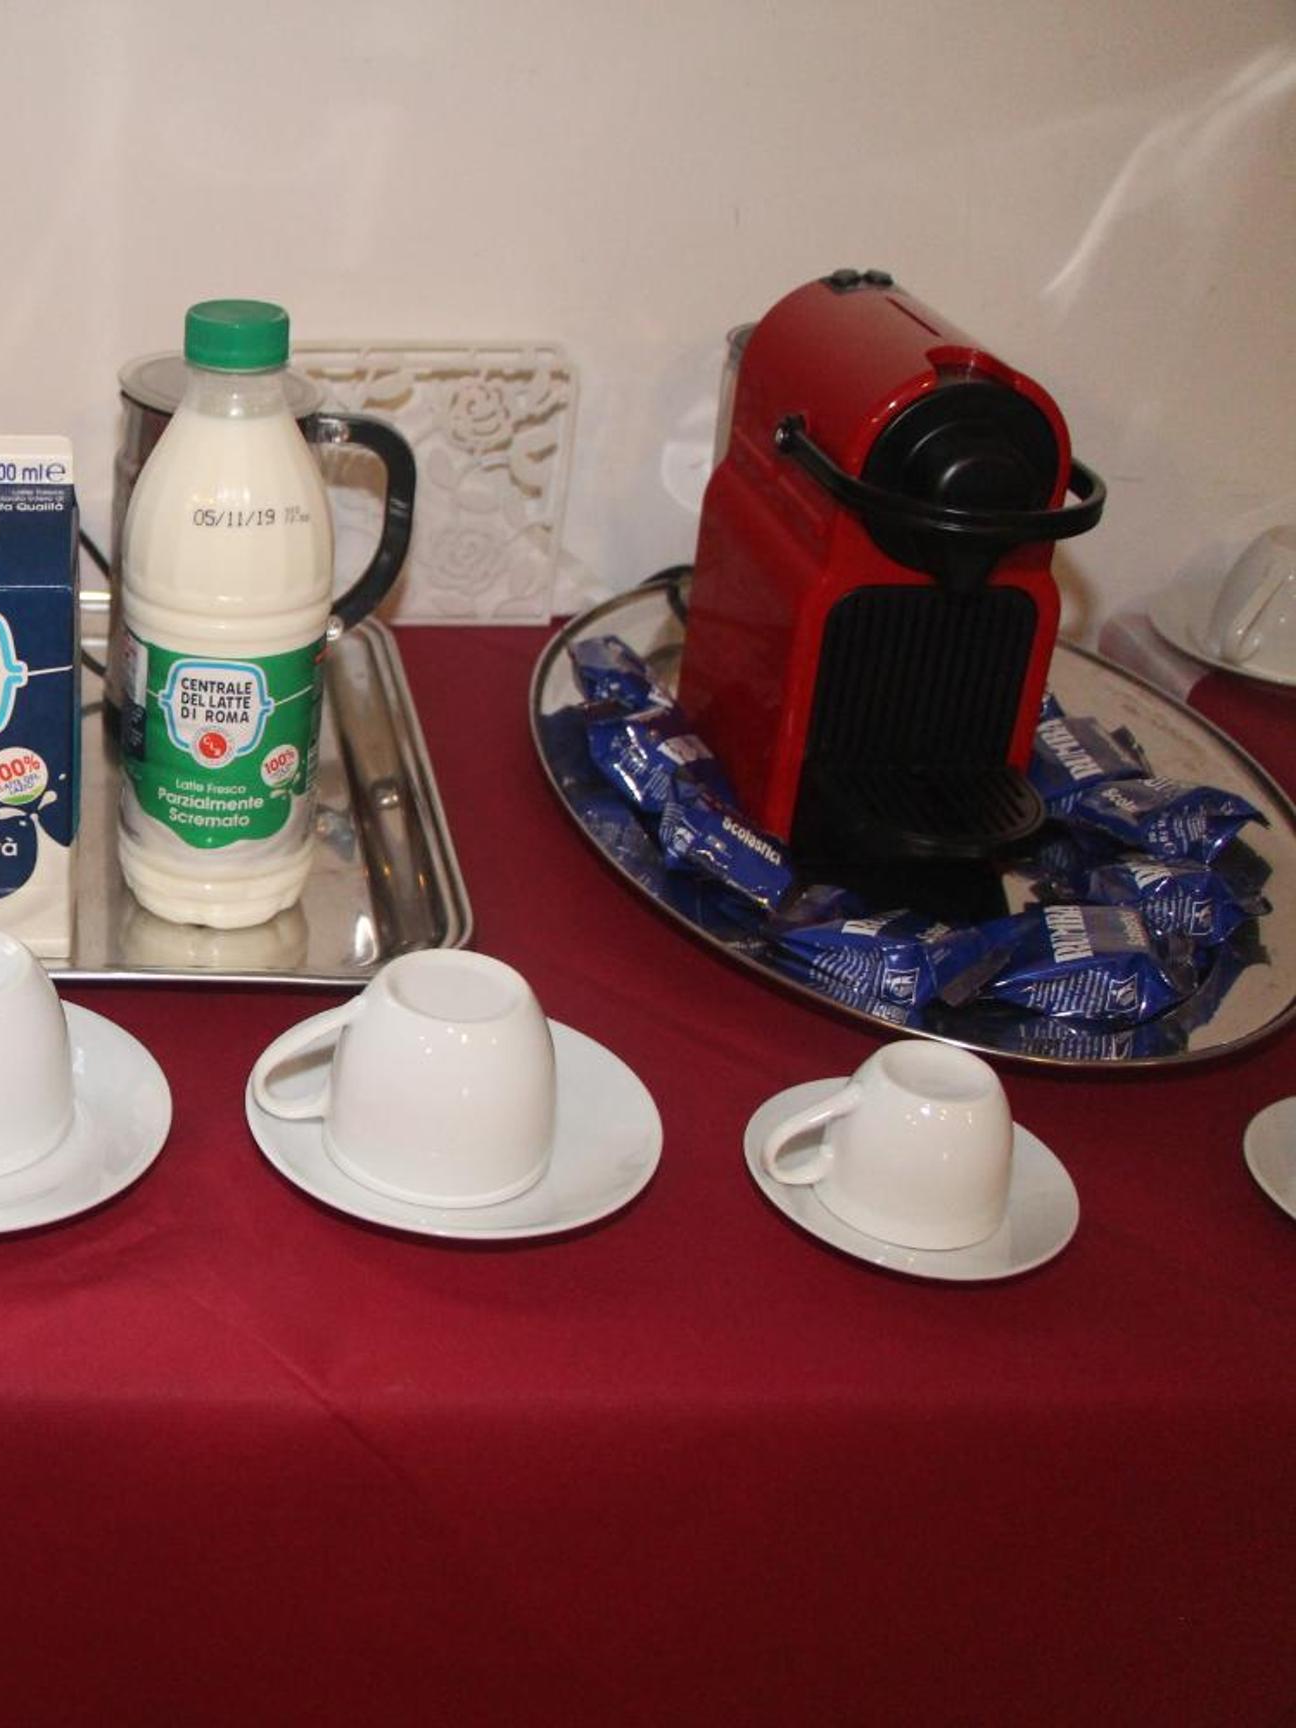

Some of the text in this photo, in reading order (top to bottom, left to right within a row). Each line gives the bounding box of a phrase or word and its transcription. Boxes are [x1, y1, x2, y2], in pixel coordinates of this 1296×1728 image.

[22, 463, 44, 481] ml
[193, 508, 275, 528] 05/11/19
[181, 677, 252, 695] CENTRALE
[181, 692, 251, 709] DEL LATTE
[181, 706, 249, 723] DI ROMA
[158, 787, 264, 811] Parzialmente
[169, 806, 250, 827] Scremato
